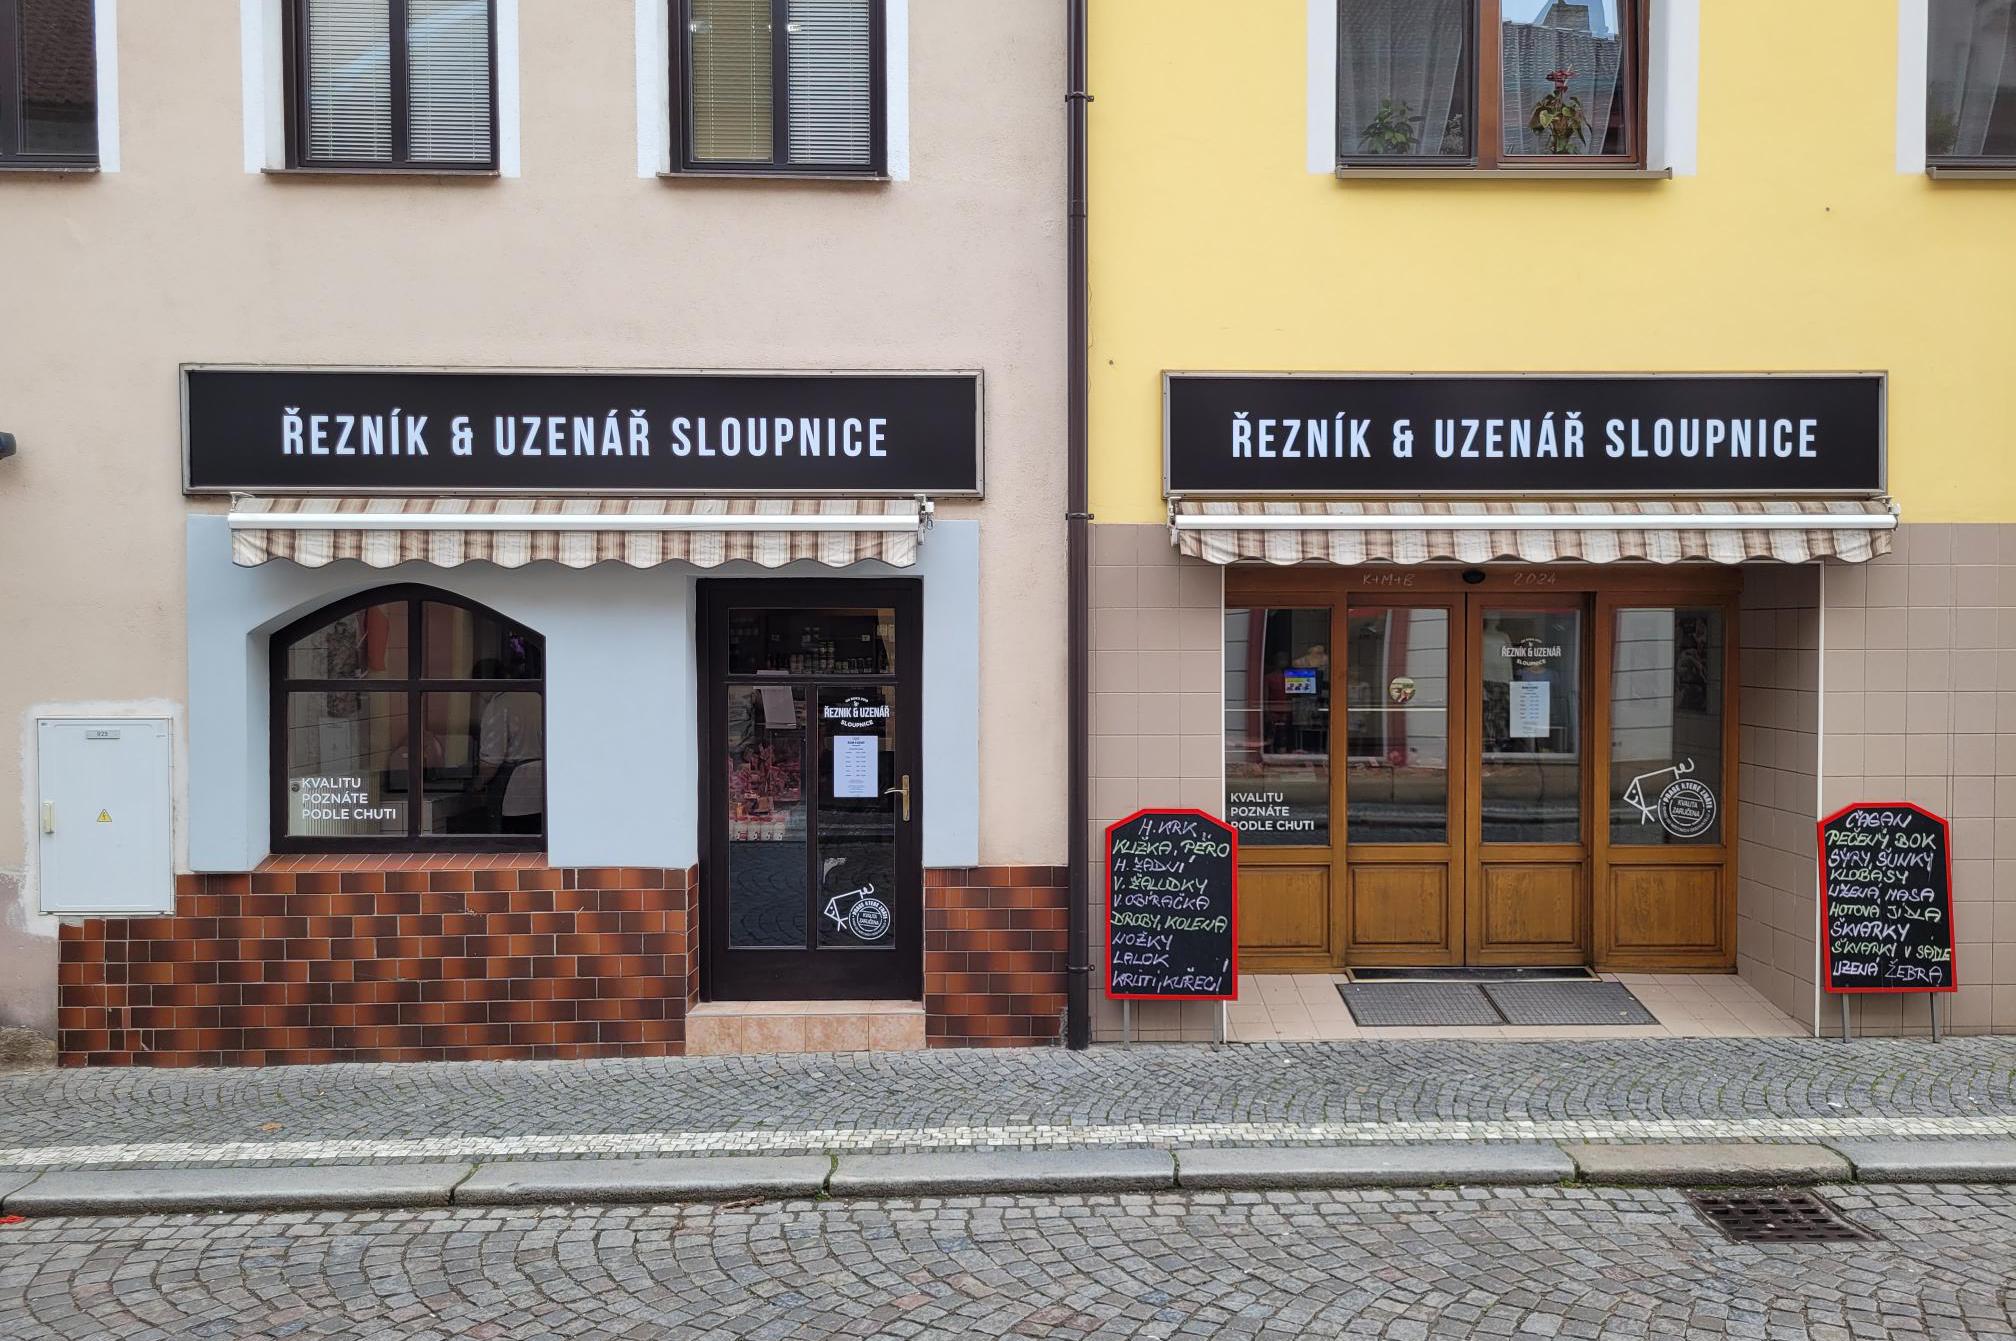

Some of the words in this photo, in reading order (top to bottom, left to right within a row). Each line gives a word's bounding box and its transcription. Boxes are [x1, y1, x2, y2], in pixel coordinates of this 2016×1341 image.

[283, 407, 429, 456] ŘEZNÍK
[451, 416, 474, 456] &
[495, 408, 650, 457] UZENÁŘ
[671, 416, 887, 457] SLOUPNICE
[1232, 411, 1371, 458] ŘEZNÍK
[1392, 419, 1414, 458] &
[1435, 411, 1584, 458] UZENÁŘ
[1605, 418, 1817, 458] SLOUPNICE
[1513, 572, 1556, 585] 2024
[1528, 647, 1533, 657] &
[1534, 645, 1562, 657] UZENÁŘ
[853, 708, 859, 718] &
[859, 705, 890, 718] UZENÁŘ
[840, 719, 874, 728] SLOUPNICE
[301, 777, 361, 789] KVALITU
[301, 790, 369, 804] POZNÁTE
[1230, 792, 1284, 803] KVALITU
[301, 808, 350, 820] PODLE
[353, 808, 396, 820] CHUTI
[1230, 804, 1290, 817] POZNÁTE
[1231, 820, 1273, 831] PODLE
[1276, 820, 1315, 831] CHUTI
[1825, 828, 1889, 849] PEČENÝ
[1895, 832, 1937, 850] BOK
[1876, 847, 1934, 871] ŠUNKY
[1830, 866, 1909, 885] KLOBÁSY
[1885, 887, 1935, 902] MASA
[1164, 915, 1228, 933] KOLENA
[1831, 917, 1910, 942] ŠKVARKY
[1112, 930, 1173, 950] NOŽKY
[1831, 938, 1897, 957] ŠKVARKY
[1904, 945, 1912, 958] V
[1113, 951, 1169, 968] LALOK
[1833, 957, 1880, 976] UZENÁ
[1885, 958, 1942, 984] ŽEBRA
